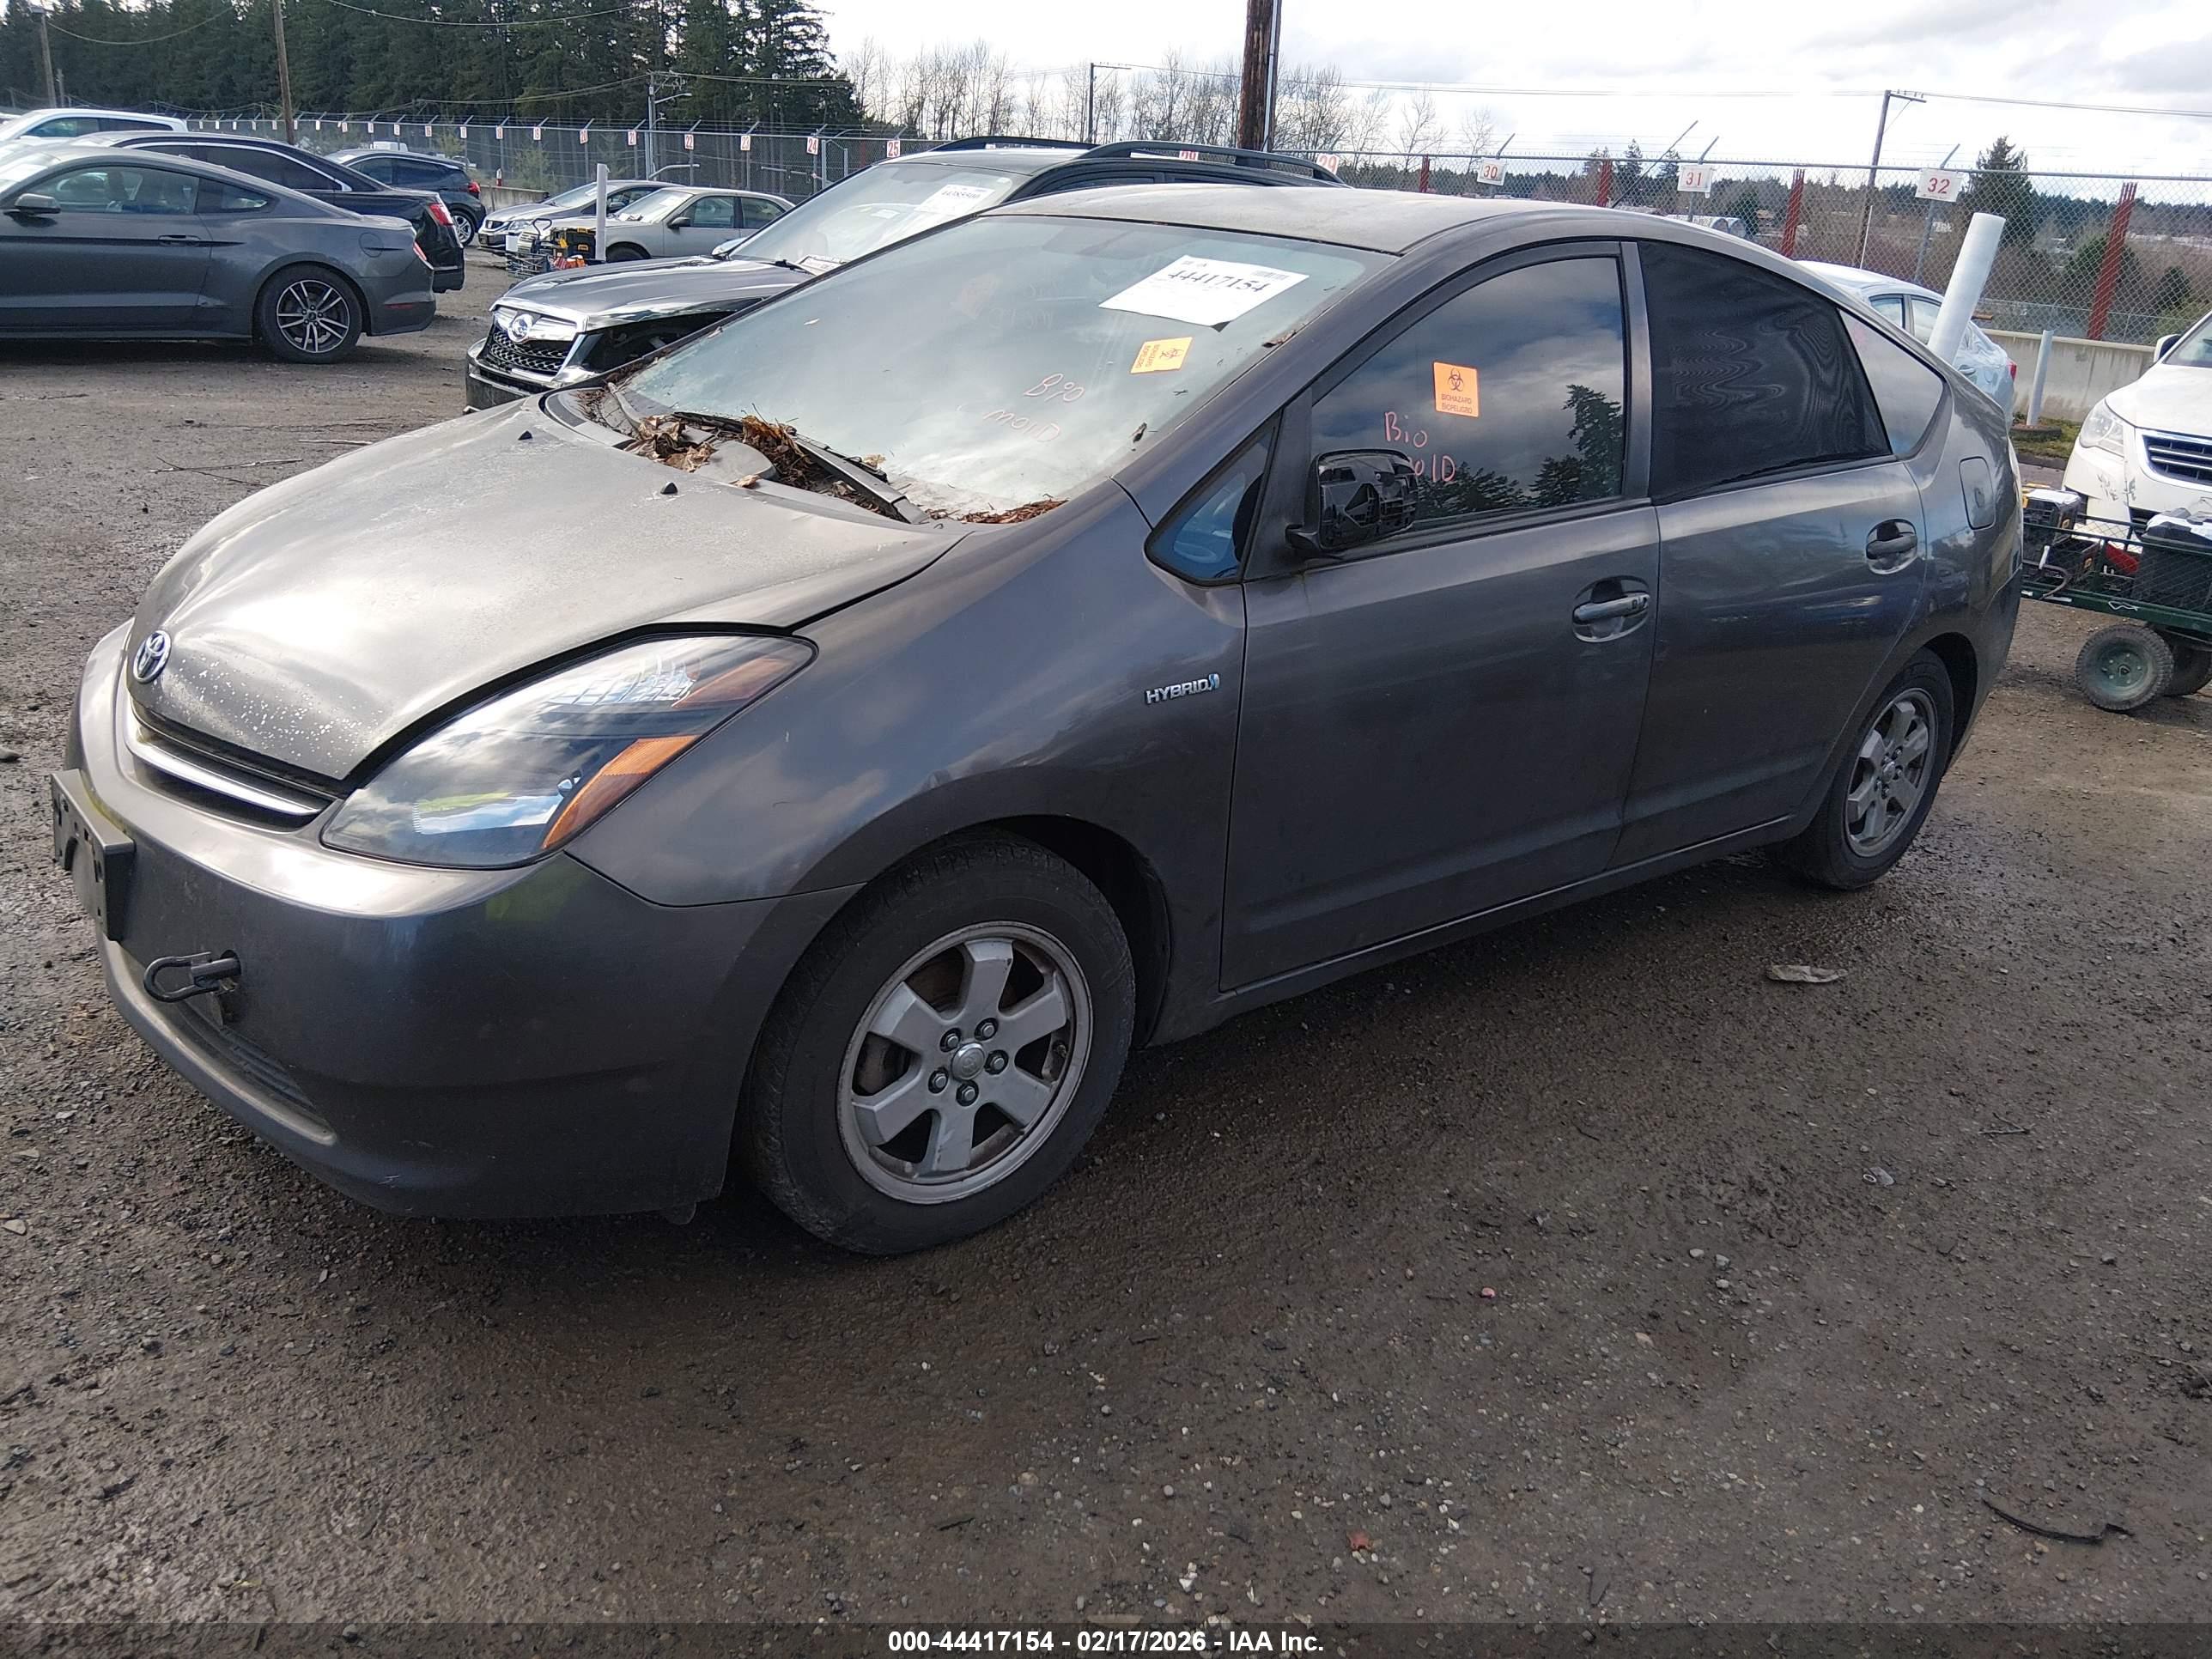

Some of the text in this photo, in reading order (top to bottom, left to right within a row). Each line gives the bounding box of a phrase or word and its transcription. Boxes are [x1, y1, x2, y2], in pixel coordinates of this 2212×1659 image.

[580, 129, 587, 143] 20
[629, 131, 635, 144] 21
[686, 135, 693, 149] 22
[741, 135, 750, 149] 23
[808, 137, 817, 154] 24
[888, 141, 900, 157] 25
[1483, 165, 1498, 179] 30
[1686, 171, 1702, 186] 31
[1927, 177, 1951, 194] 32
[1167, 270, 1271, 293] 44417154
[1384, 411, 1428, 448] Bio
[1146, 678, 1210, 704] HYBRID
